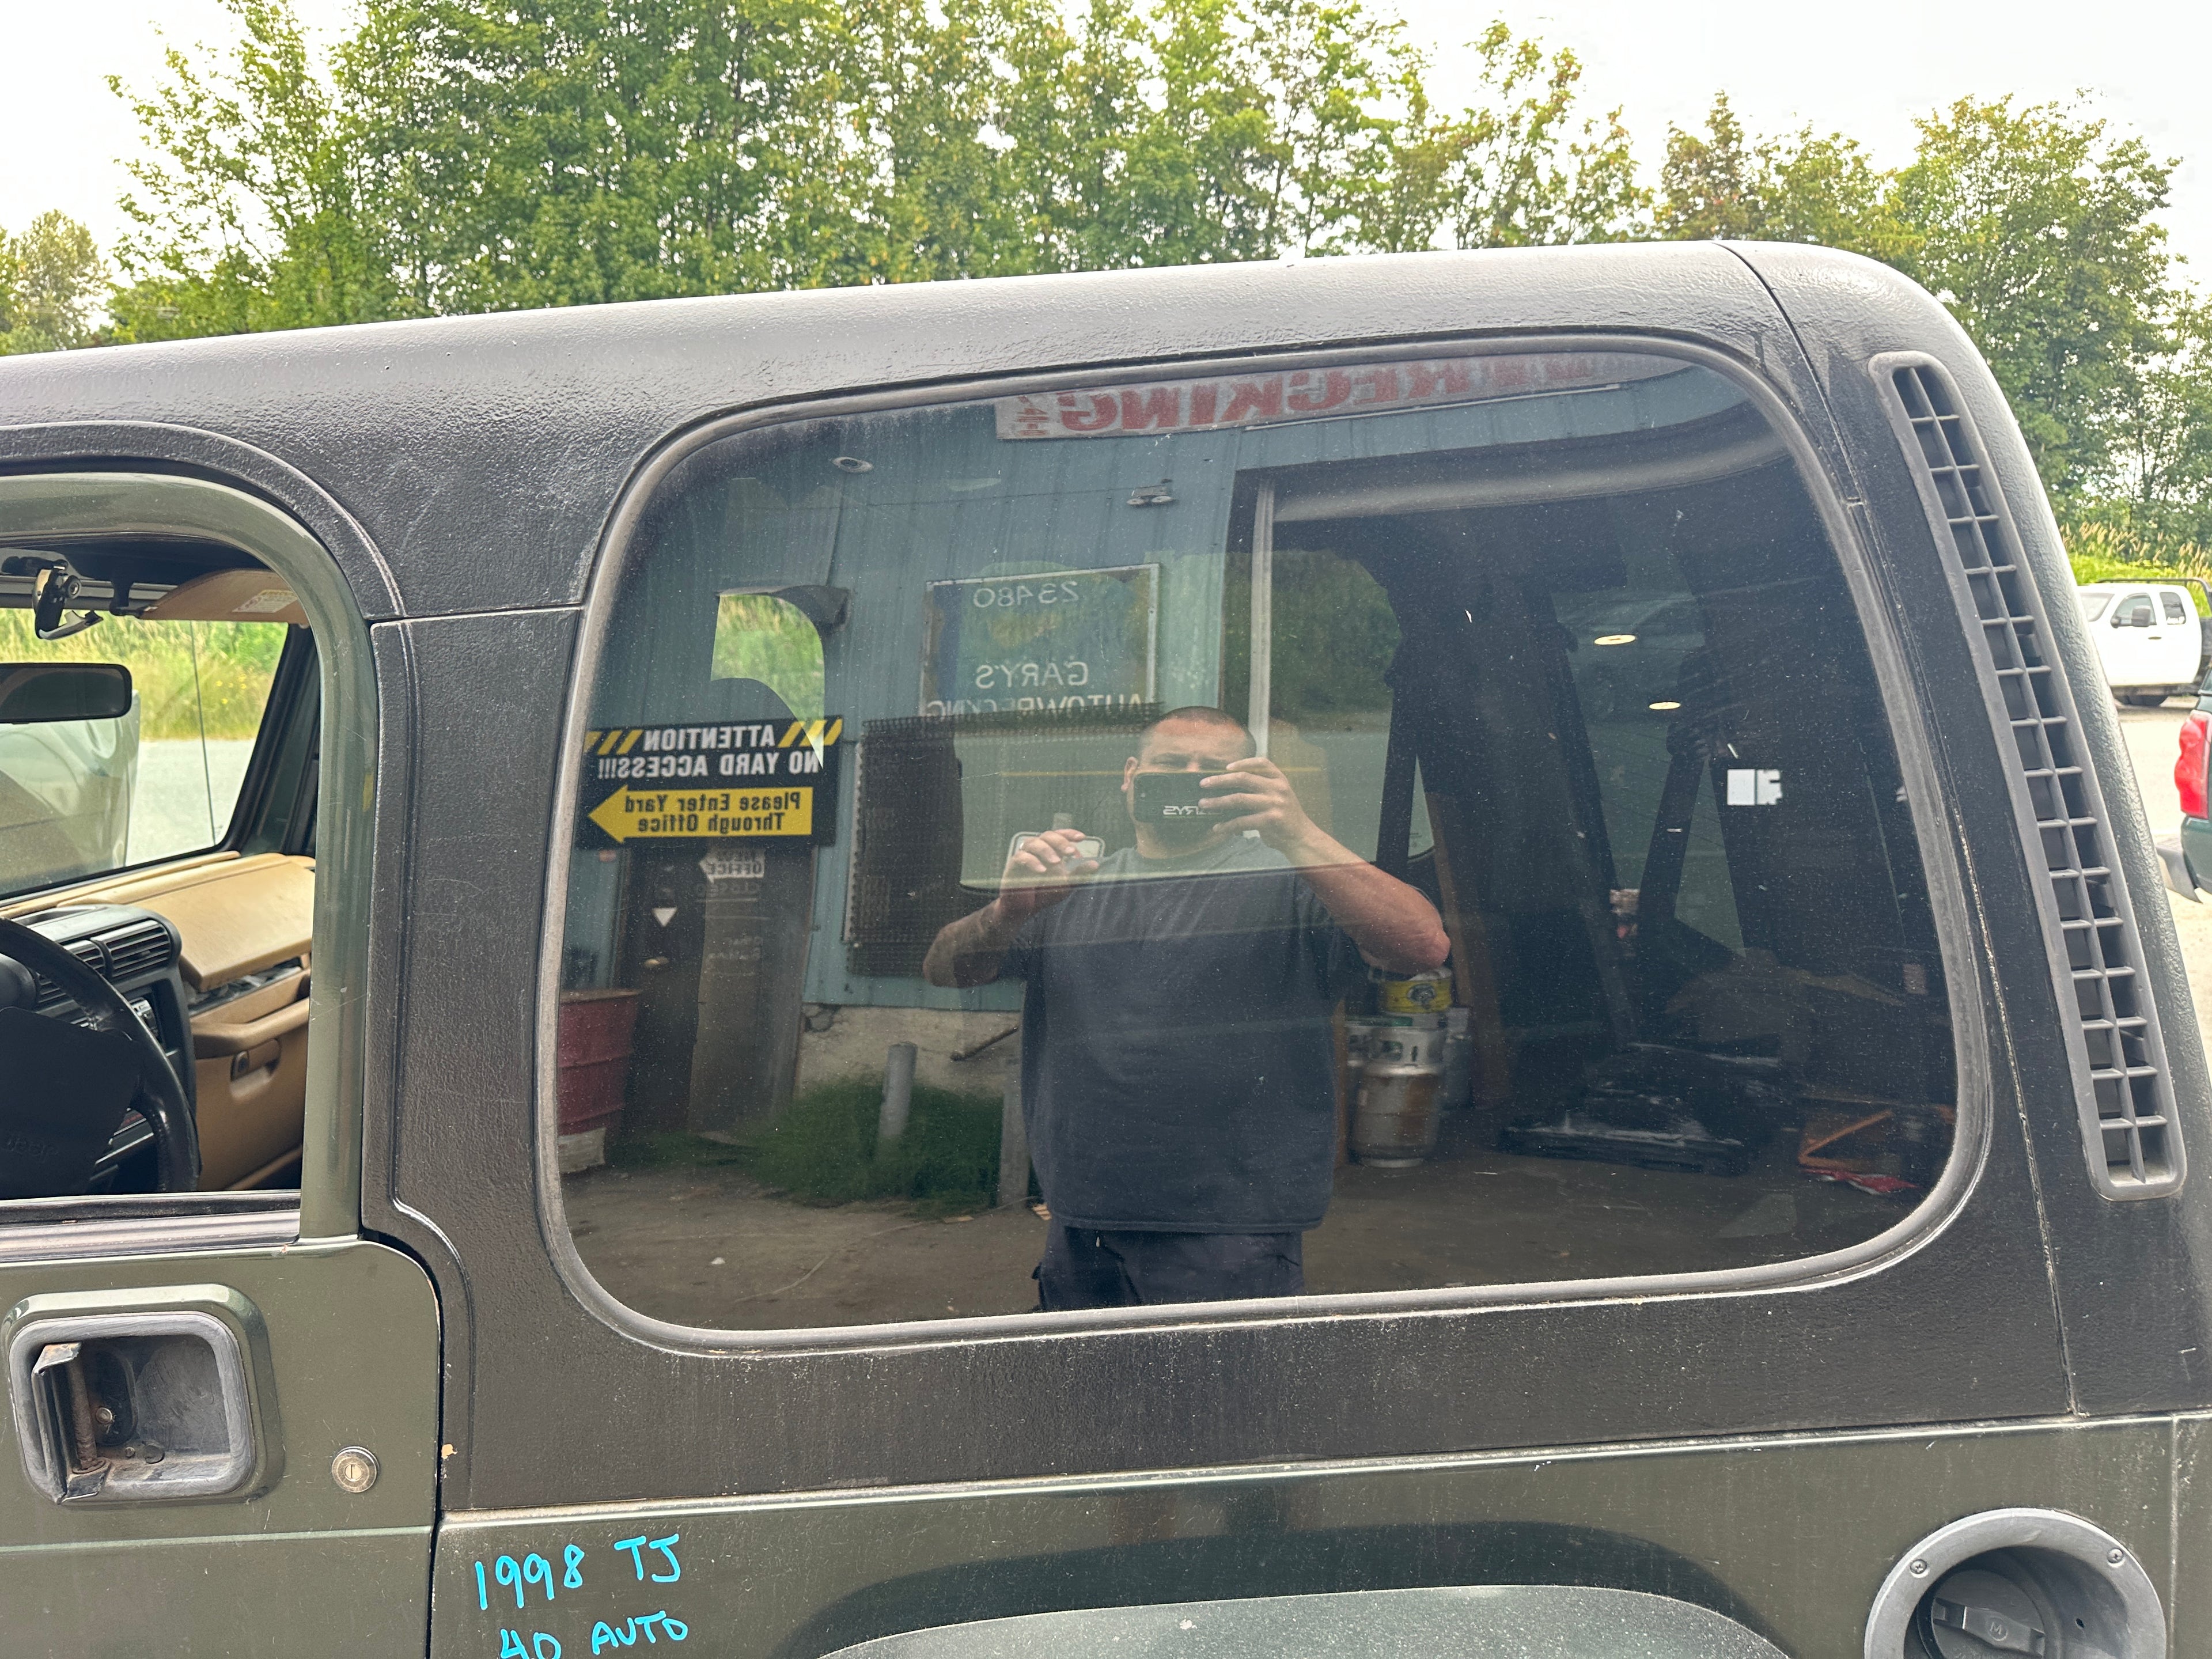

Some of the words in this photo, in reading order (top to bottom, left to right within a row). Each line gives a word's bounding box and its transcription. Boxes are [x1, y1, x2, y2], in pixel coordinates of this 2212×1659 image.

[475, 1544, 585, 1610] 1998
[614, 1533, 681, 1583] TJ
[591, 1610, 688, 1656] AUTO
